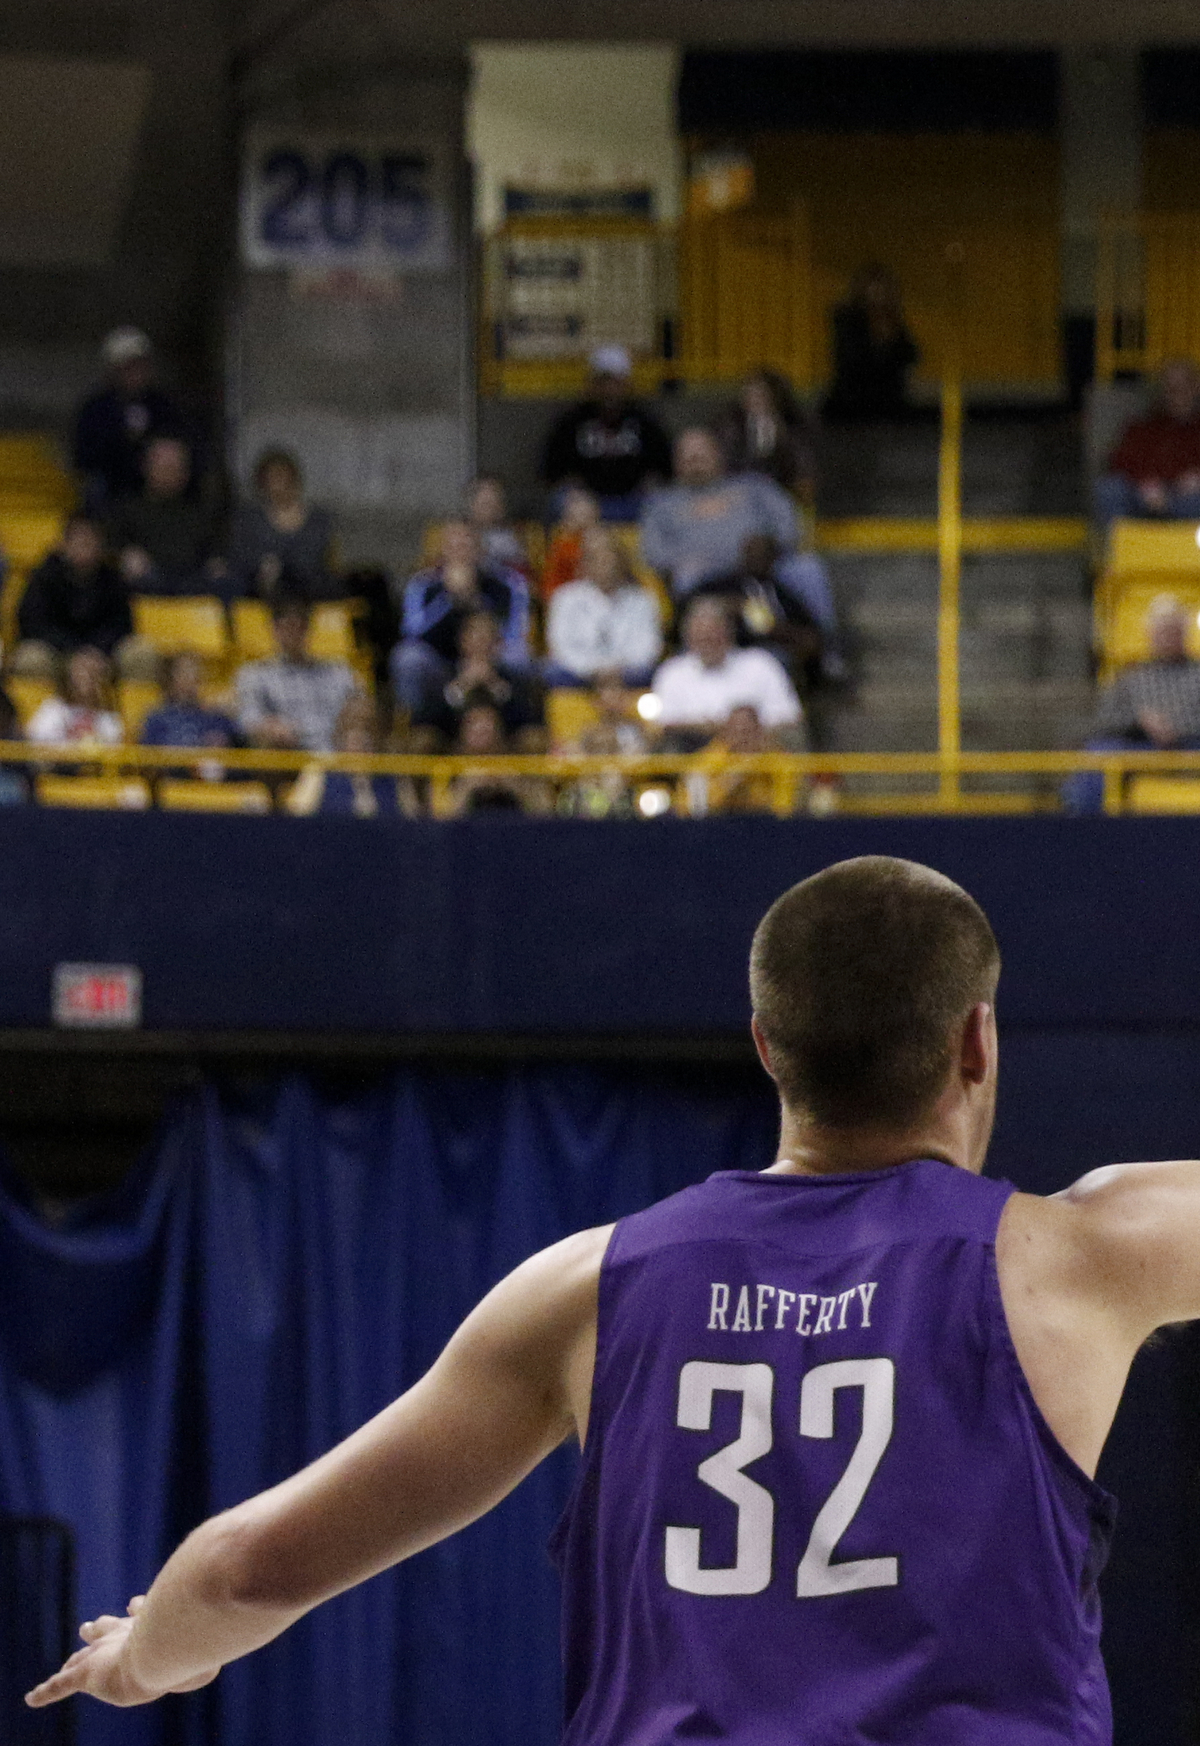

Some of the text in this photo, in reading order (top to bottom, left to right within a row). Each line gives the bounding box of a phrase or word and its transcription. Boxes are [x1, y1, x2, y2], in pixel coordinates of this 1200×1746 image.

[263, 152, 431, 249] 205
[707, 1282, 878, 1336] RAFFERTY
[664, 1357, 898, 1597] 32
